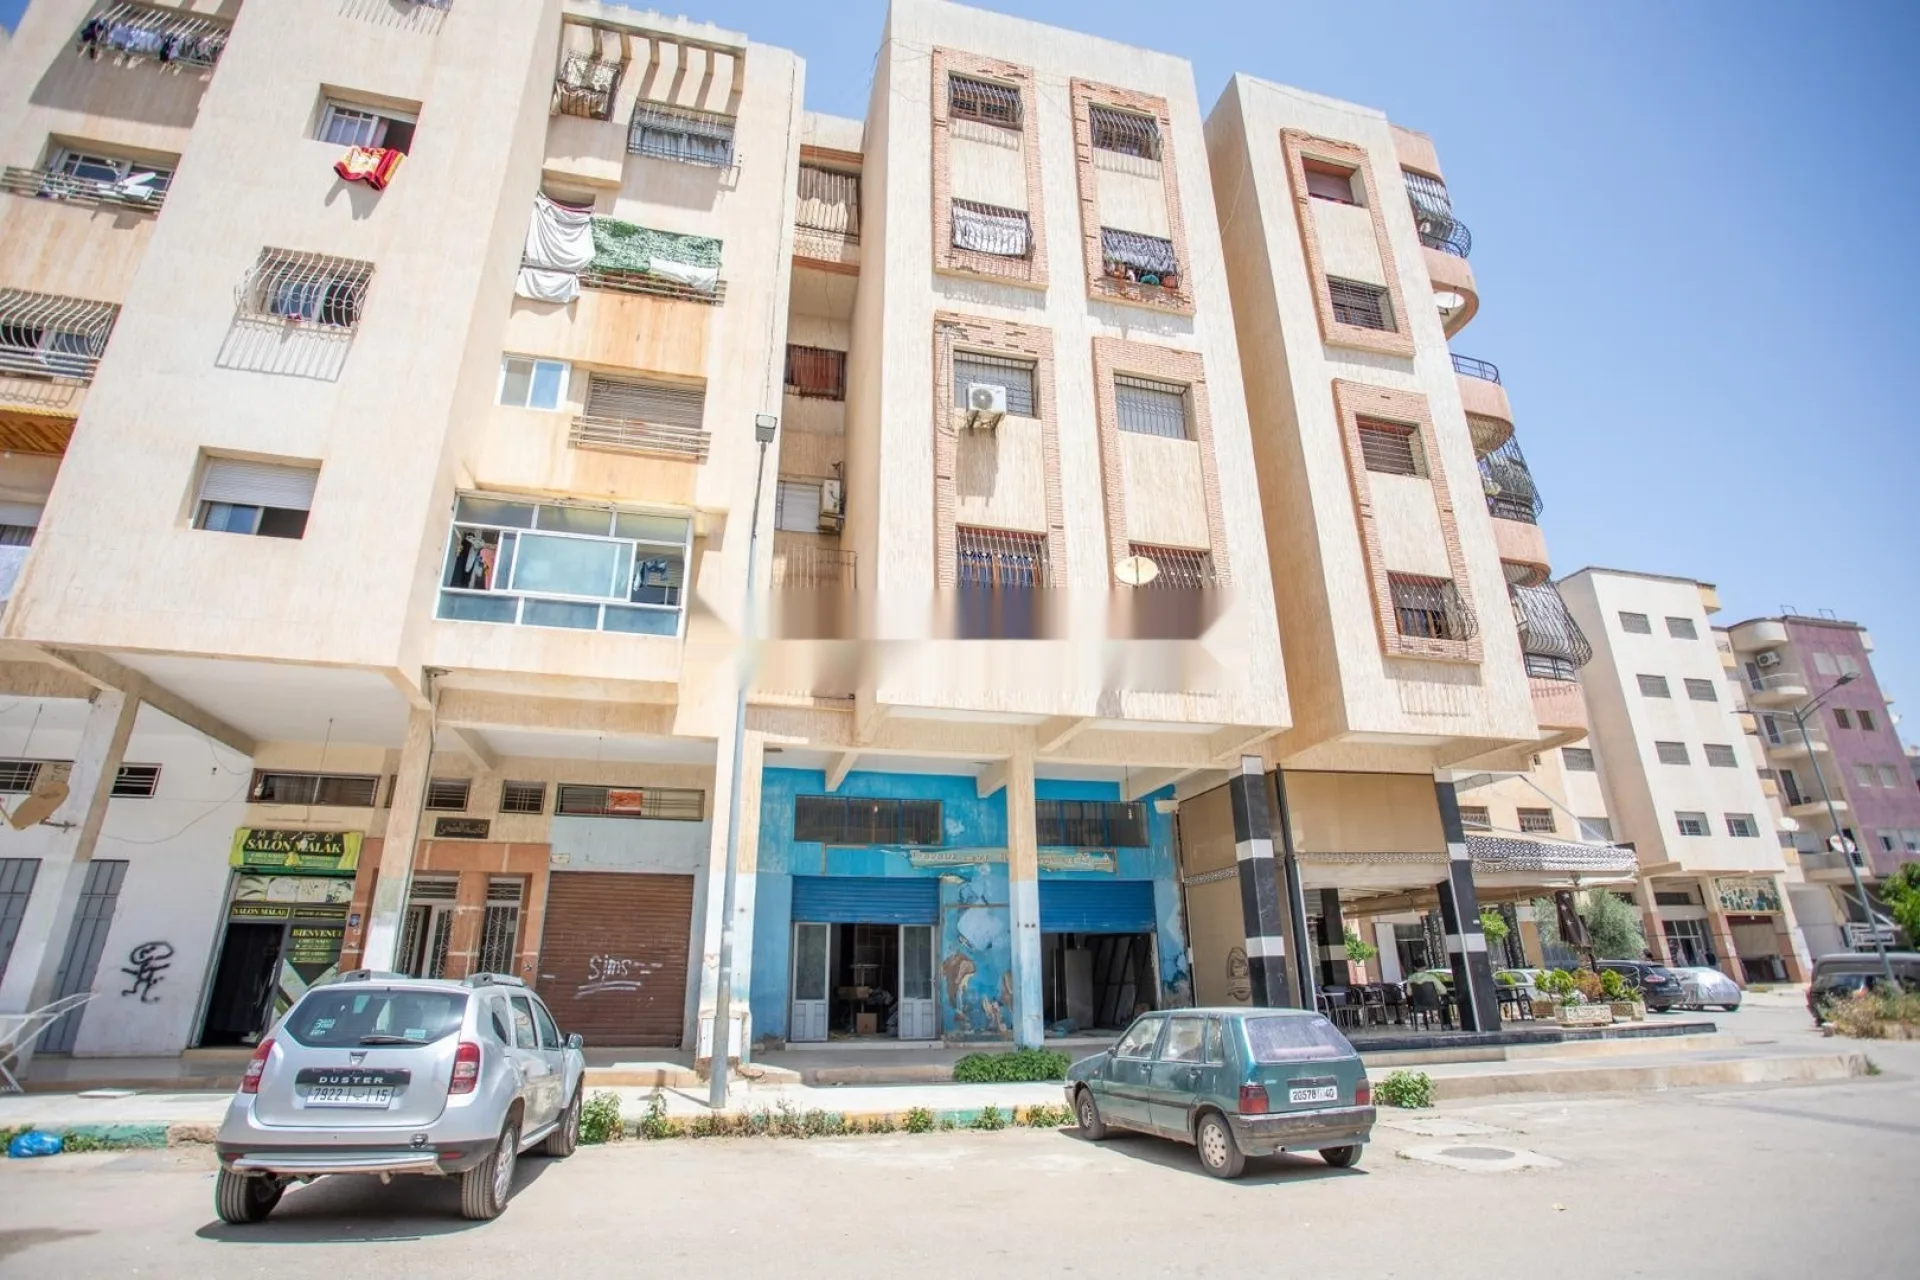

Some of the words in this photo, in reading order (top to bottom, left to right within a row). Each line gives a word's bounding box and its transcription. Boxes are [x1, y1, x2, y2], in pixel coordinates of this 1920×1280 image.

[246, 838, 291, 851] SALON
[294, 840, 341, 853] MALAK
[319, 1076, 384, 1084] DUSTER
[313, 1087, 343, 1101] 7922
[375, 1088, 389, 1102] 15
